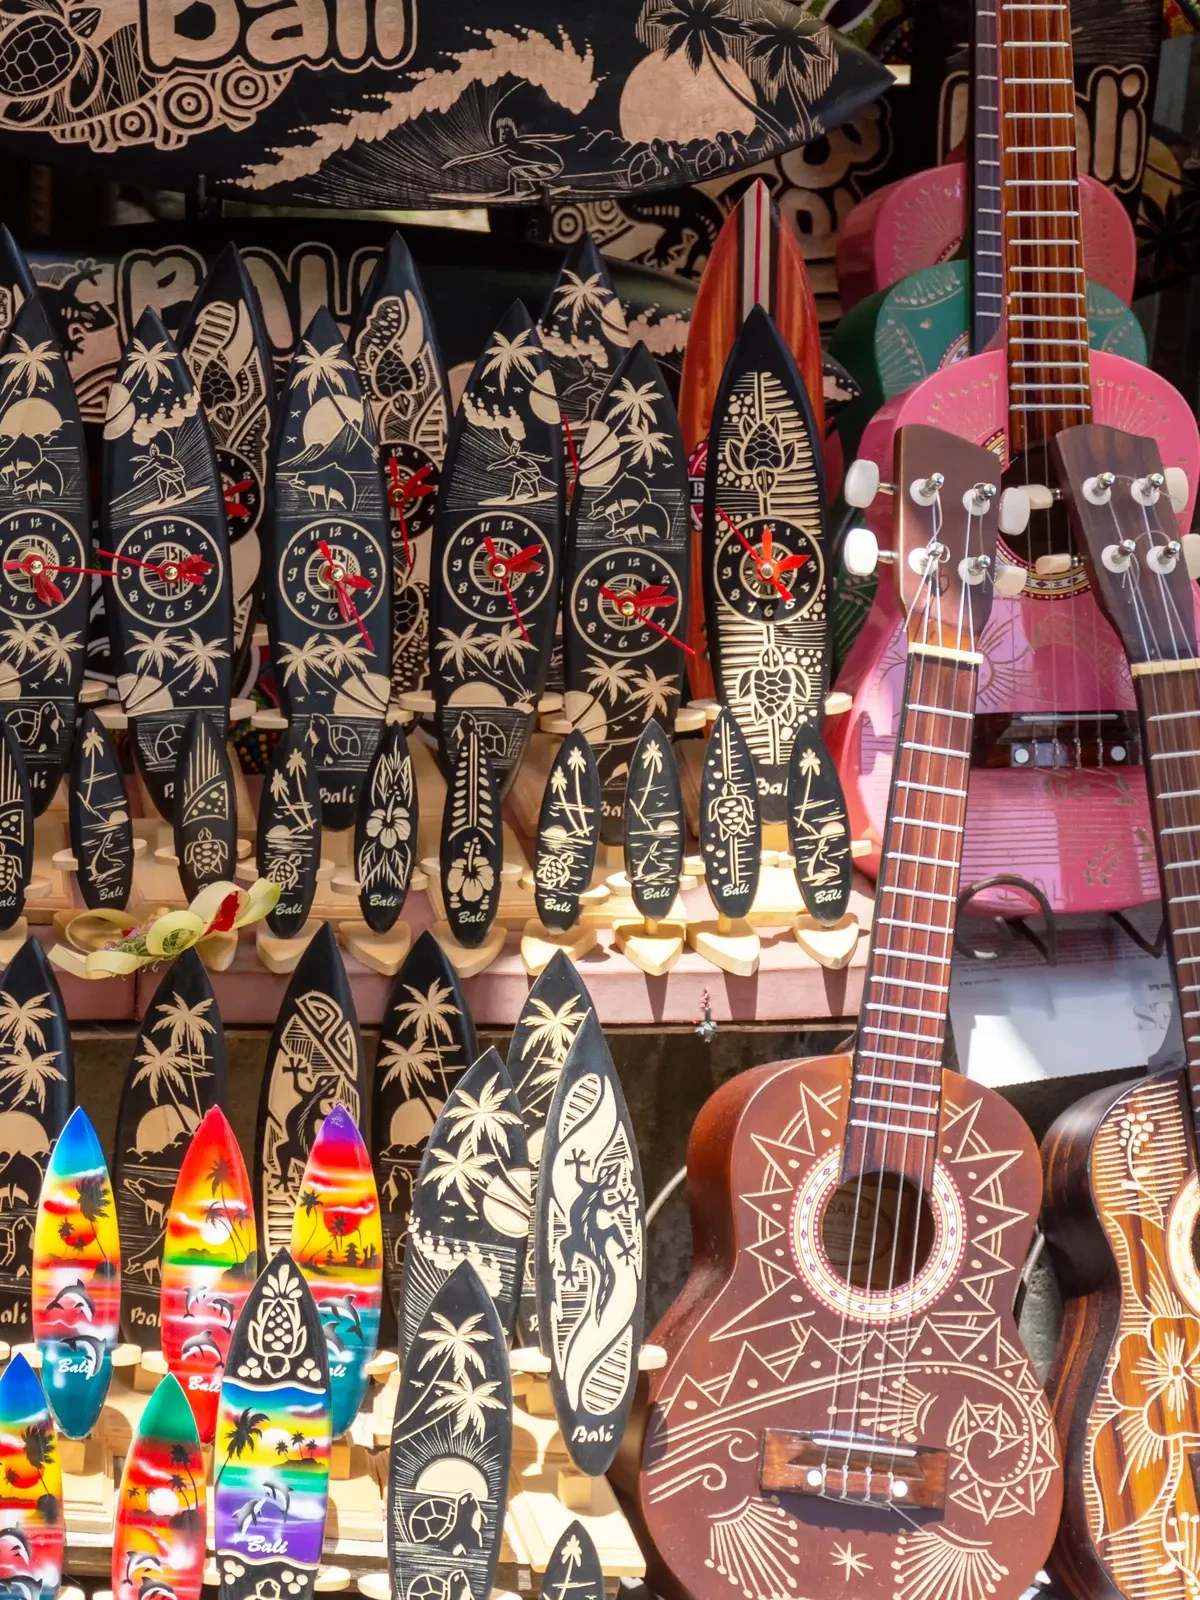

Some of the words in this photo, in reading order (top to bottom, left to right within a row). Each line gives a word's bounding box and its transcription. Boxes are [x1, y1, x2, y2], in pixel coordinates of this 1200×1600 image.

[10, 520, 19, 531] 11
[30, 518, 42, 528] 12
[51, 523, 56, 531] 1
[412, 521, 421, 531] 5
[480, 522, 490, 532] 11
[501, 520, 514, 531] 12
[143, 529, 152, 540] 11
[163, 524, 175, 536] 12
[185, 528, 191, 536] 1
[310, 530, 319, 540] 11
[329, 526, 342, 537] 12
[352, 531, 358, 540] 1
[523, 527, 529, 536] 1
[744, 528, 754, 538] 11
[785, 528, 791, 536] 1
[62, 533, 71, 542] 2
[460, 537, 474, 546] 10
[798, 537, 807, 547] 2
[128, 544, 141, 554] 10
[199, 541, 208, 550] 2
[293, 546, 306, 555] 10
[364, 545, 374, 553] 2
[727, 544, 741, 554] 10
[67, 556, 76, 567] 3
[452, 559, 462, 571] 9
[606, 560, 615, 570] 11
[628, 558, 640, 567] 12
[651, 563, 656, 571] 1
[807, 561, 817, 572] 3
[121, 566, 131, 579] 9
[287, 567, 298, 581] 9
[369, 567, 378, 578] 3
[722, 567, 732, 579] 9
[62, 579, 71, 589] 4
[584, 578, 599, 587] 10
[661, 575, 670, 584] 2
[198, 584, 208, 596] 4
[458, 582, 468, 593] 8
[526, 586, 535, 597] 4
[801, 583, 810, 593] 4
[129, 590, 139, 602] 8
[295, 591, 307, 604] 8
[730, 589, 740, 600] 8
[26, 598, 35, 610] 6
[184, 600, 192, 610] 5
[486, 600, 496, 613] 6
[578, 598, 589, 612] 9
[165, 606, 174, 619] 6
[328, 608, 338, 620] 6
[764, 605, 774, 617] 6
[587, 622, 597, 633] 8
[618, 635, 628, 648] 6
[641, 632, 650, 643] 5
[755, 777, 789, 797] Bal
[99, 886, 125, 900] Bali
[642, 888, 670, 901] Bali
[721, 883, 750, 897] Bali
[369, 894, 398, 908] Bali
[814, 888, 842, 904] Bali
[275, 903, 303, 916] Bali
[543, 899, 571, 913] Bali
[458, 911, 486, 923] Bali
[58, 1357, 93, 1374] Bali
[572, 1424, 614, 1443] Bali
[247, 1535, 288, 1554] Bali
